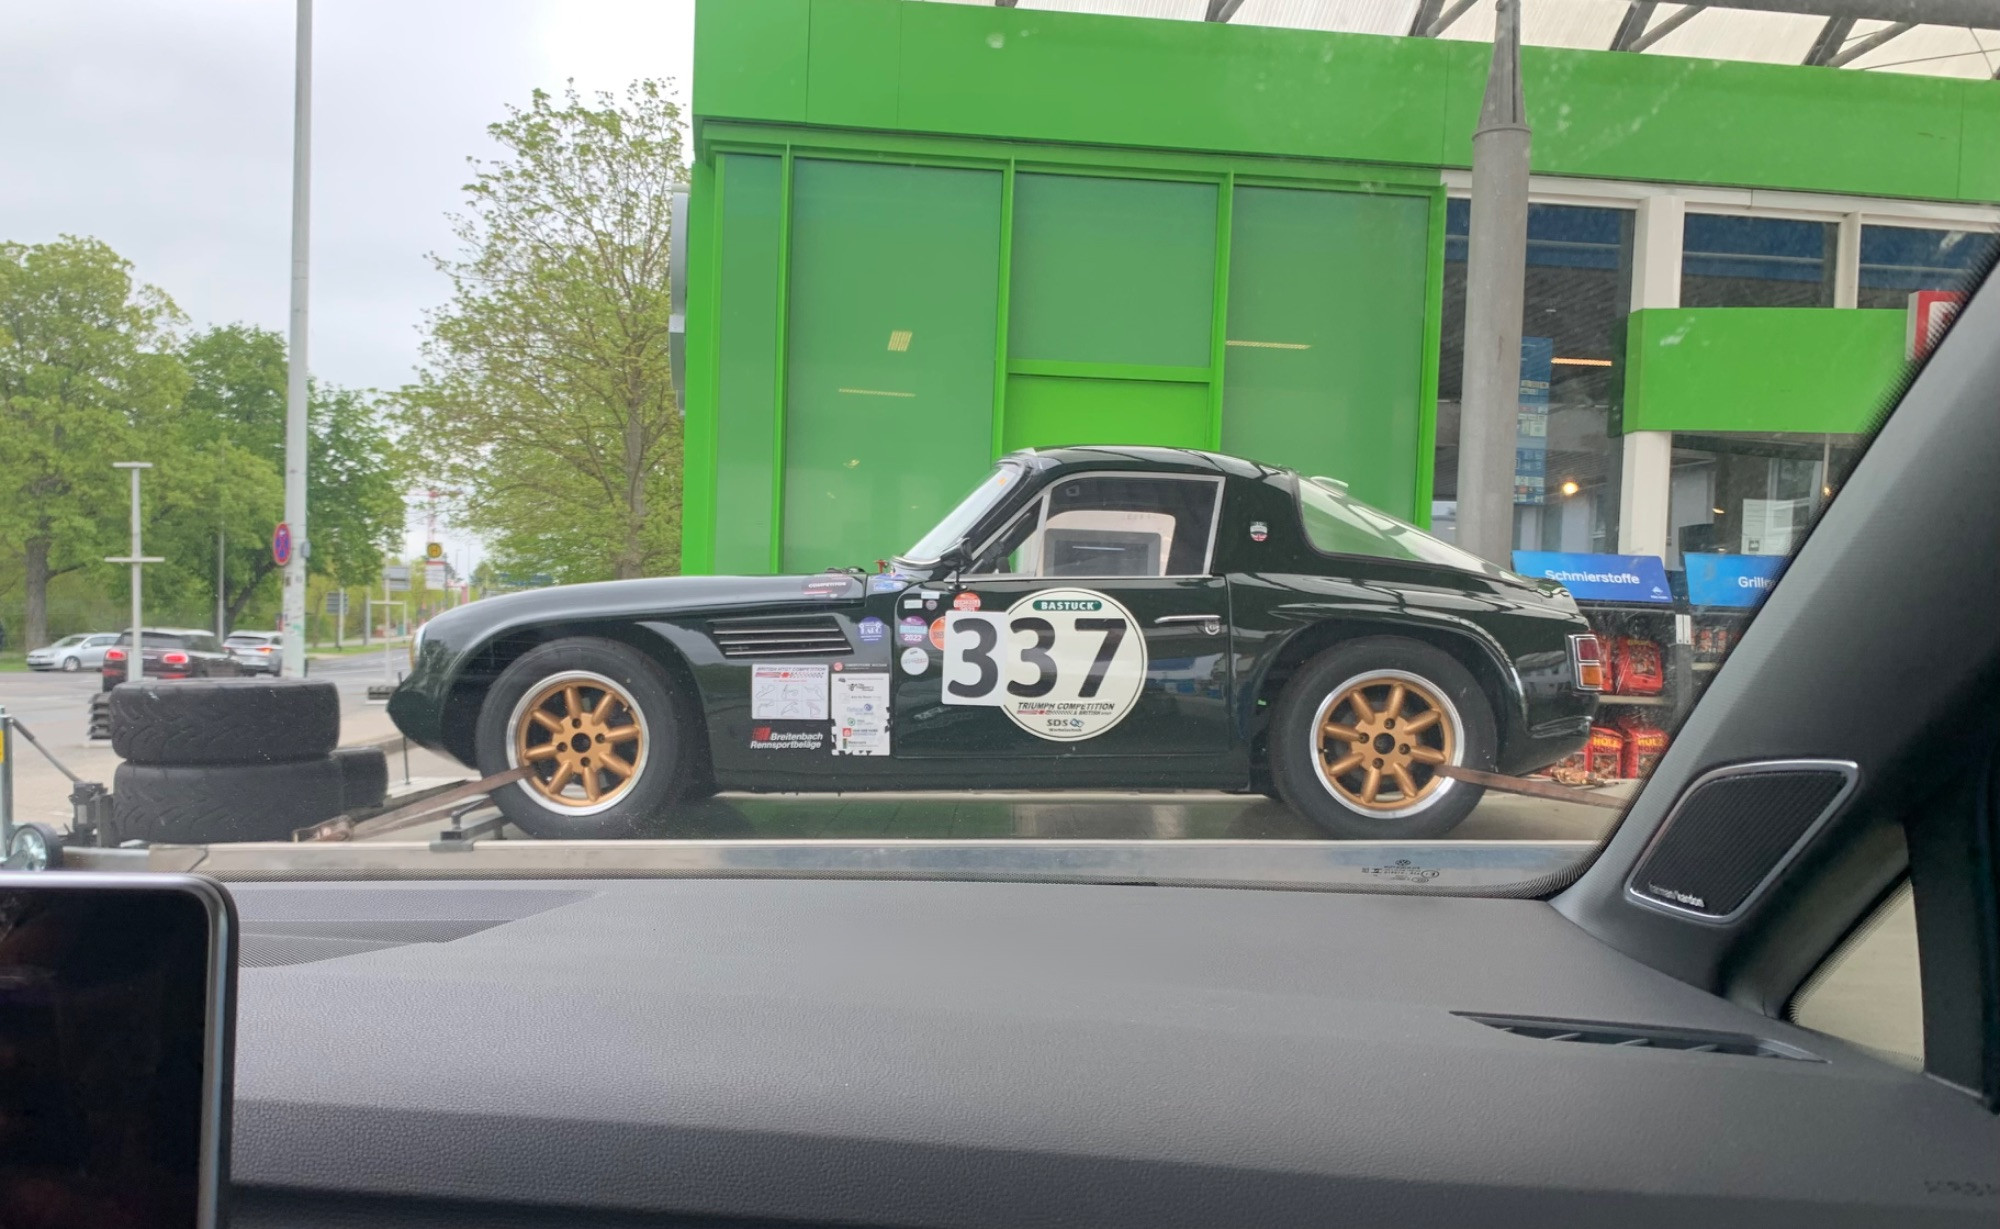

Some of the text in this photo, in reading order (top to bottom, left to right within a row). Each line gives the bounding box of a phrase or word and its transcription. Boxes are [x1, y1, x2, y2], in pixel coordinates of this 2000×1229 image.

[1544, 569, 1641, 585] Schmierstoffe
[1041, 601, 1095, 610] BASTUCK
[904, 633, 923, 642] 2022
[947, 616, 1128, 699] 337
[1017, 701, 1115, 711] TRIUMPH COMPETITION
[1046, 719, 1068, 727] SDS
[770, 732, 823, 741] Breitenbach
[750, 740, 822, 750] Rennsportbeläge
